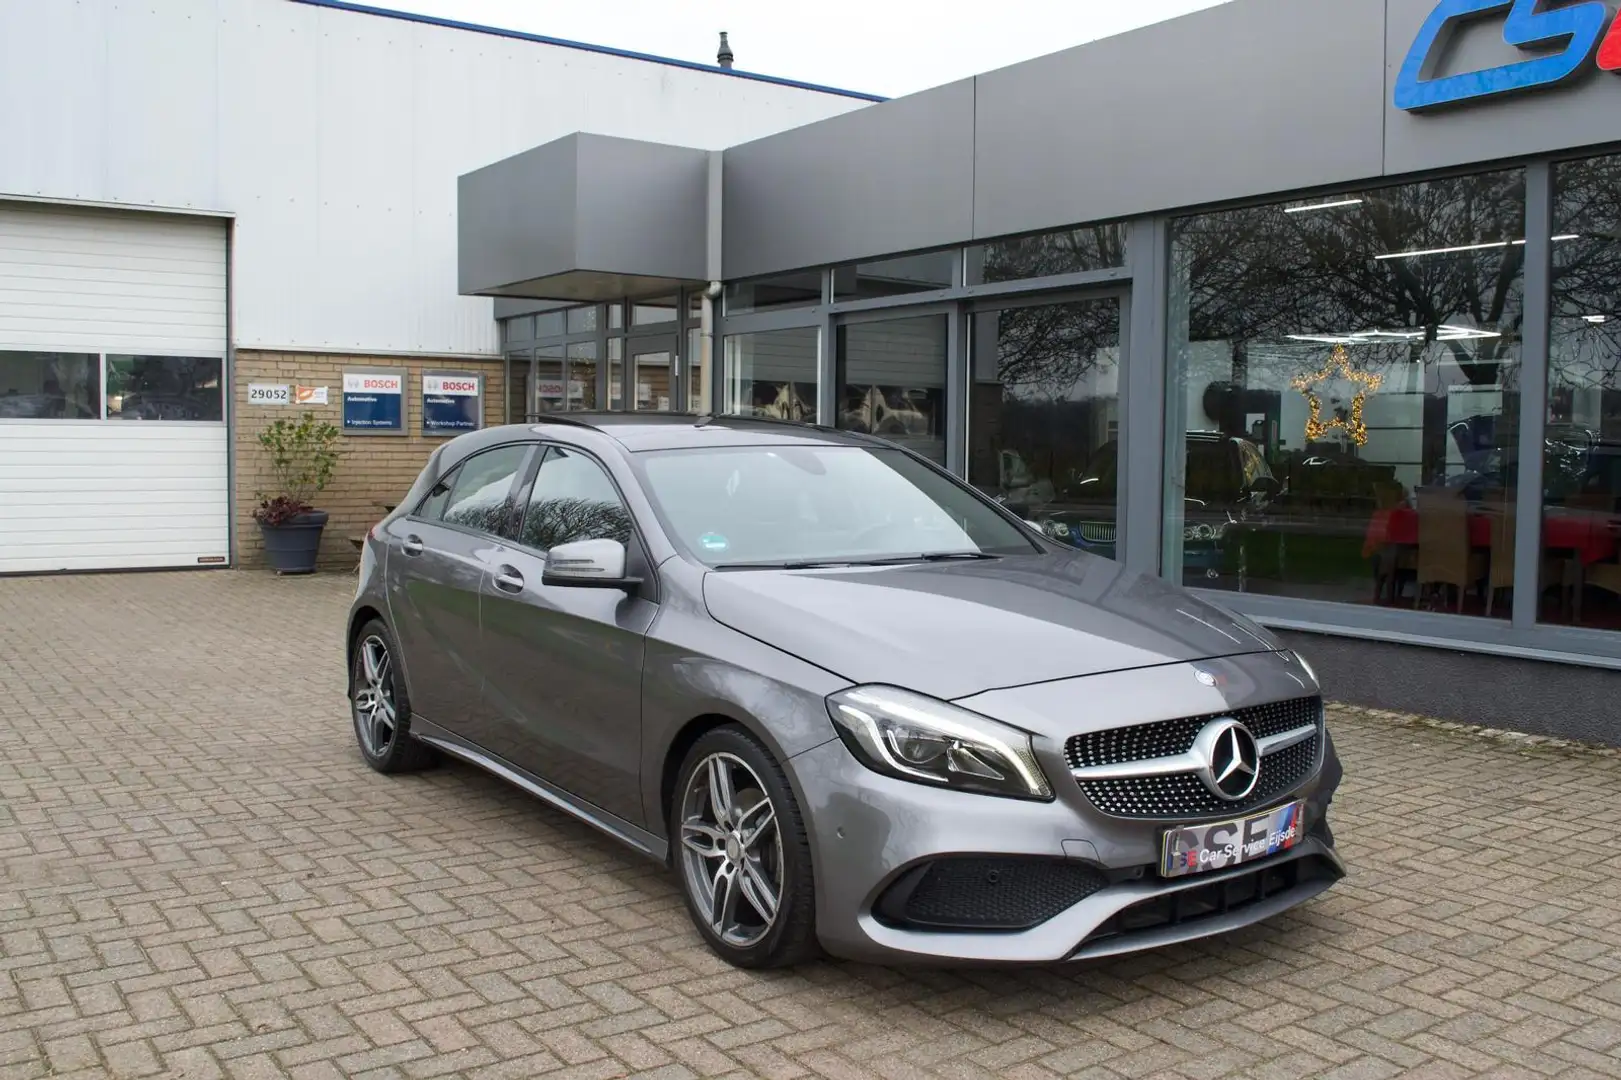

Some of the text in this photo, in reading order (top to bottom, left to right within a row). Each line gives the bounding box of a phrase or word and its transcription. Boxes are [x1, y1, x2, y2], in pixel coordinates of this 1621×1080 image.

[1394, 0, 1621, 110] CS
[364, 379, 398, 389] BOSCH
[442, 381, 475, 391] BOSCH
[251, 389, 287, 400] 29052
[1200, 849, 1222, 863] Car
[1224, 838, 1265, 859] Service
